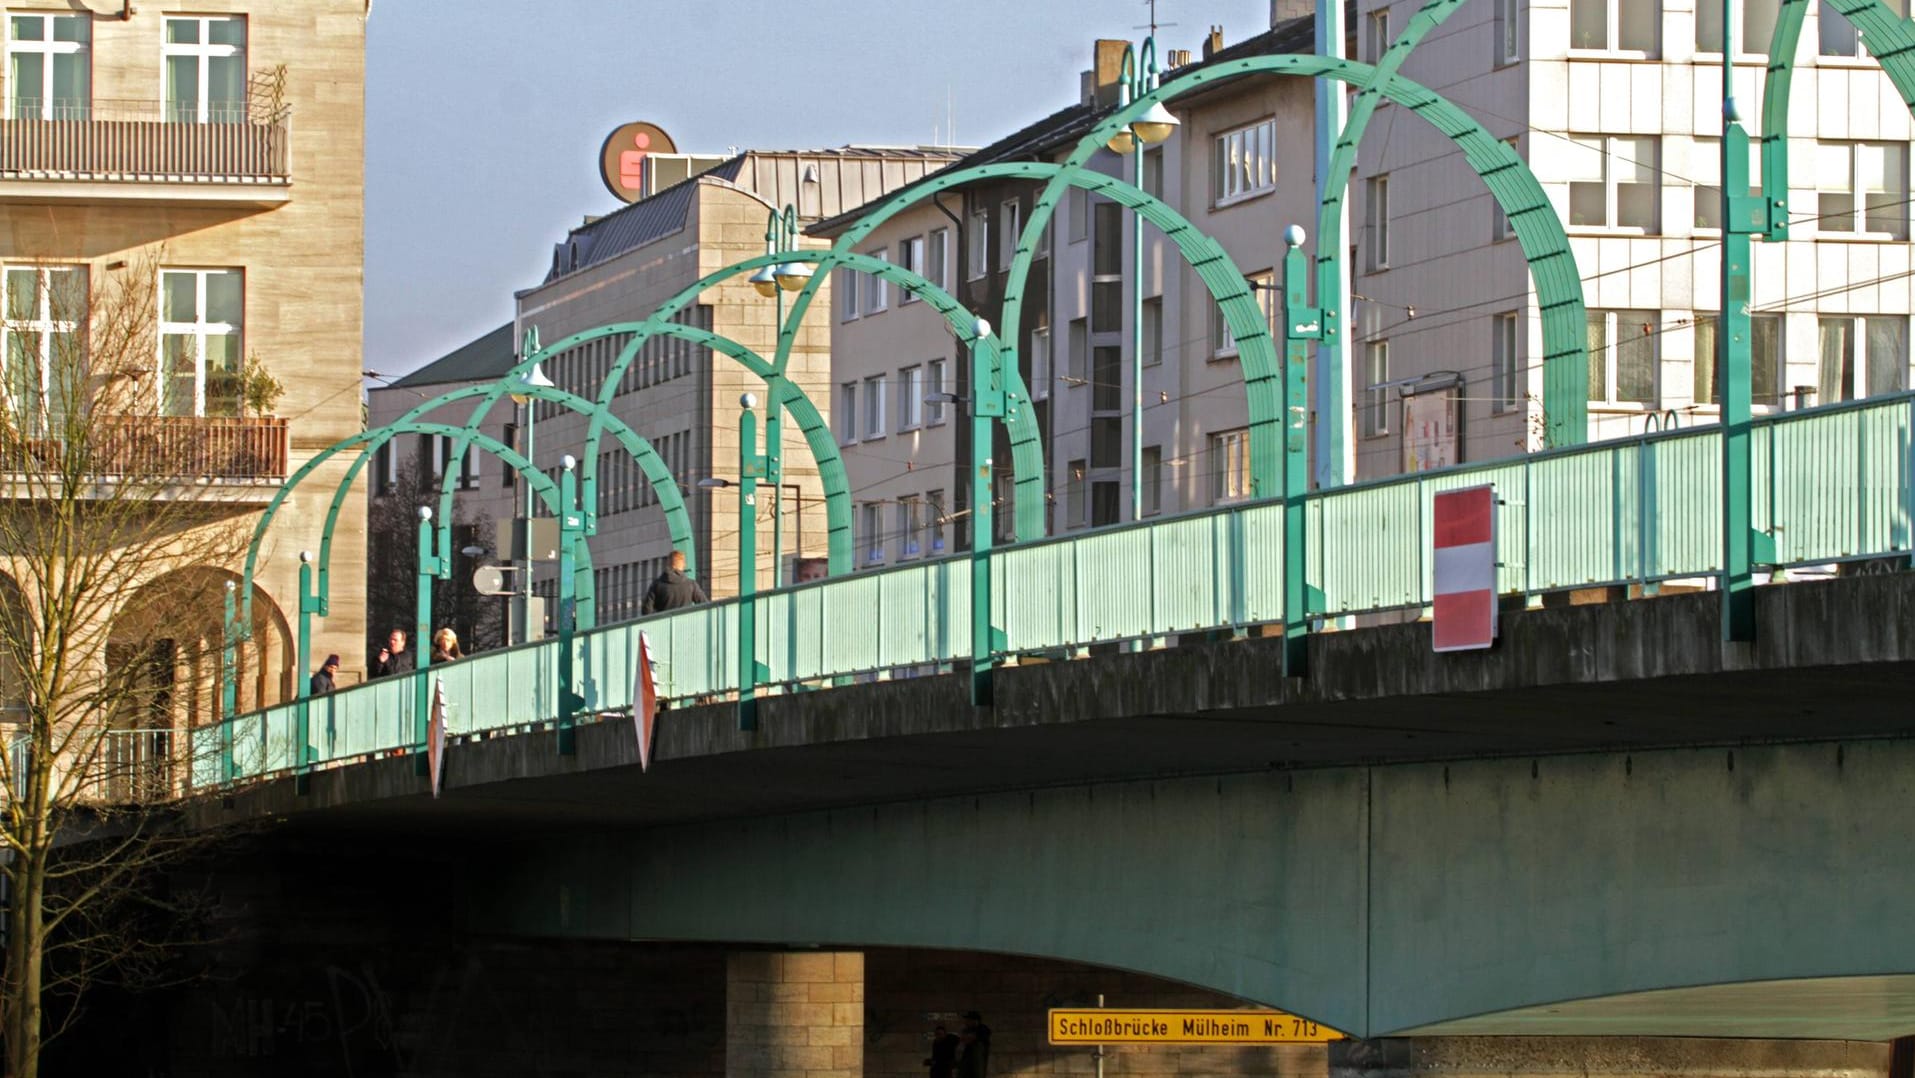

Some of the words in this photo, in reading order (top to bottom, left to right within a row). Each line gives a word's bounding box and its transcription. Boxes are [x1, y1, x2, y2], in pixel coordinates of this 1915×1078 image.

[1060, 1018, 1168, 1036] Schloßbrücke
[1183, 1018, 1249, 1036] Mülheim
[1264, 1019, 1285, 1036] Nr.
[1292, 1019, 1318, 1036] 713
